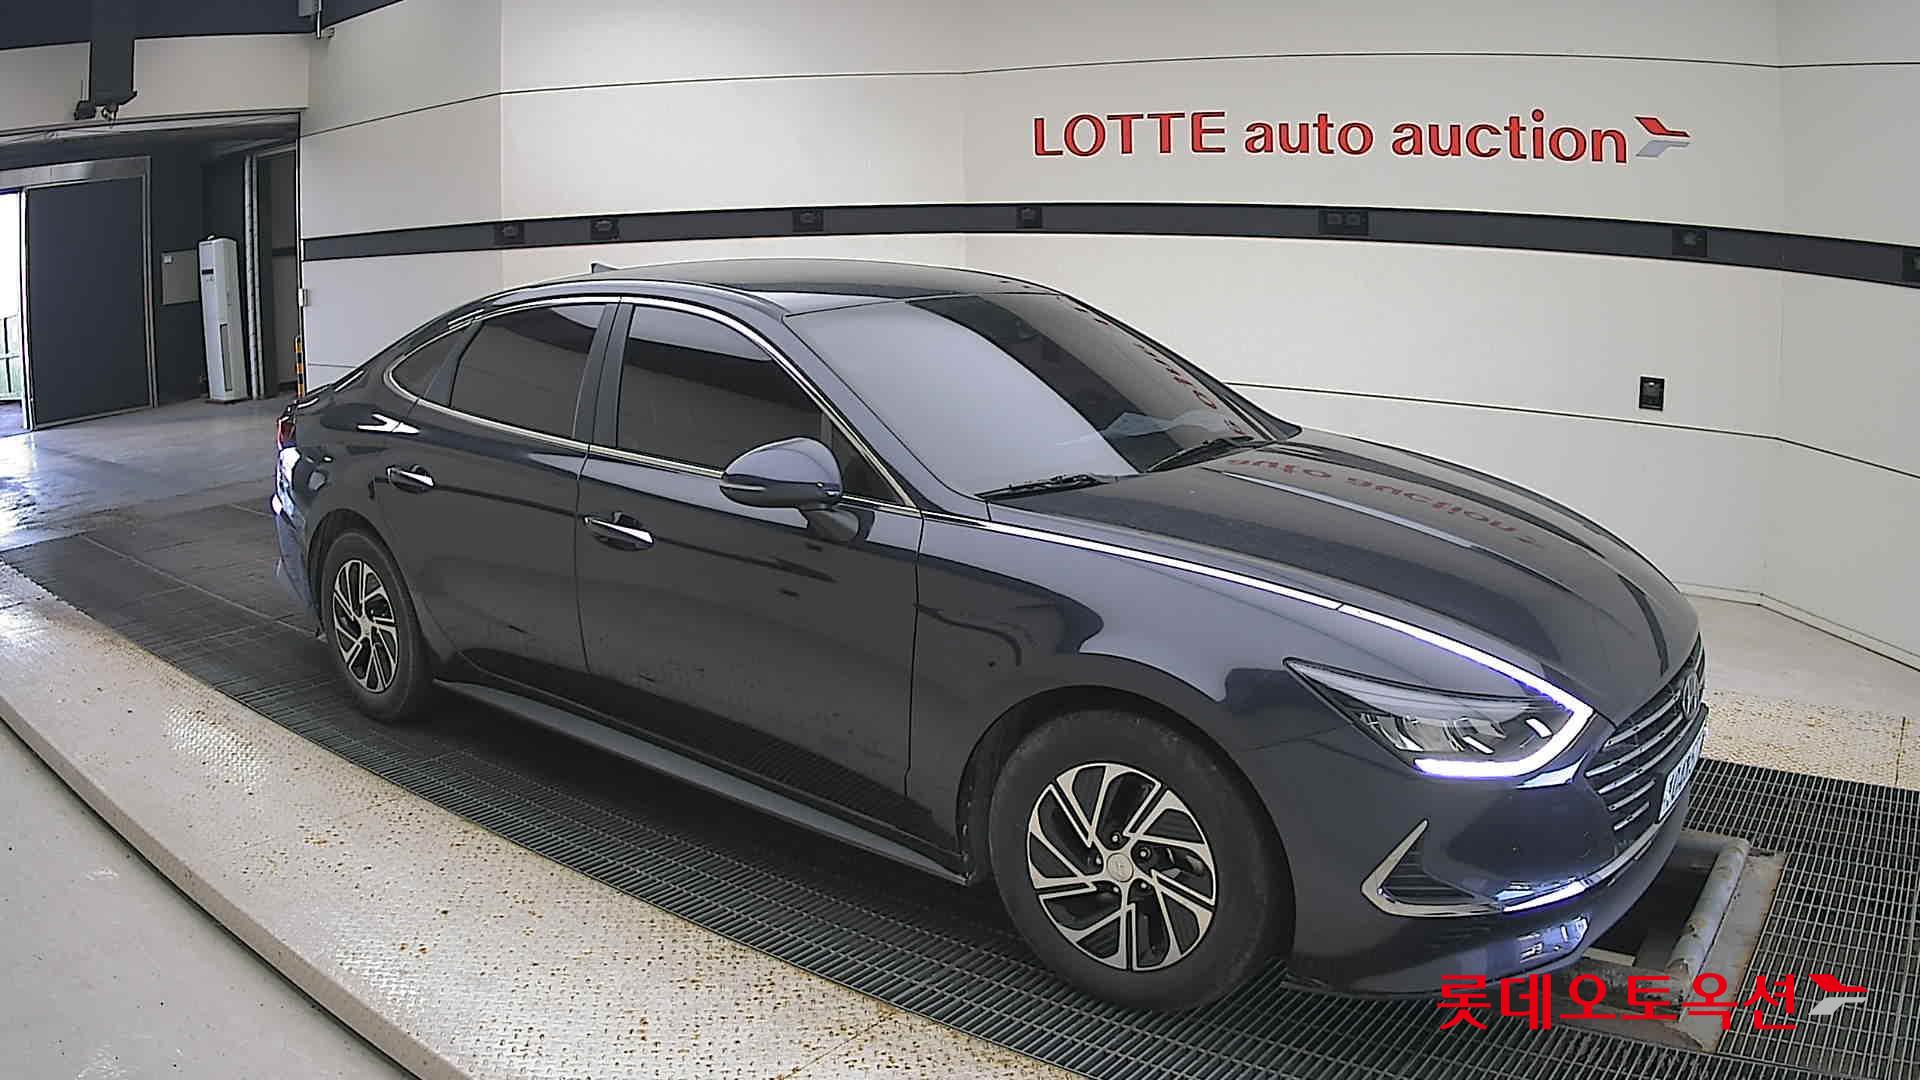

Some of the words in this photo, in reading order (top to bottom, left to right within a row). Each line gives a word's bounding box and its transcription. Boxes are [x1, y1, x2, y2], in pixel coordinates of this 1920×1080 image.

[1034, 111, 1225, 157] LOTTE
[1245, 113, 1374, 156] auto
[1392, 109, 1628, 163] auction
